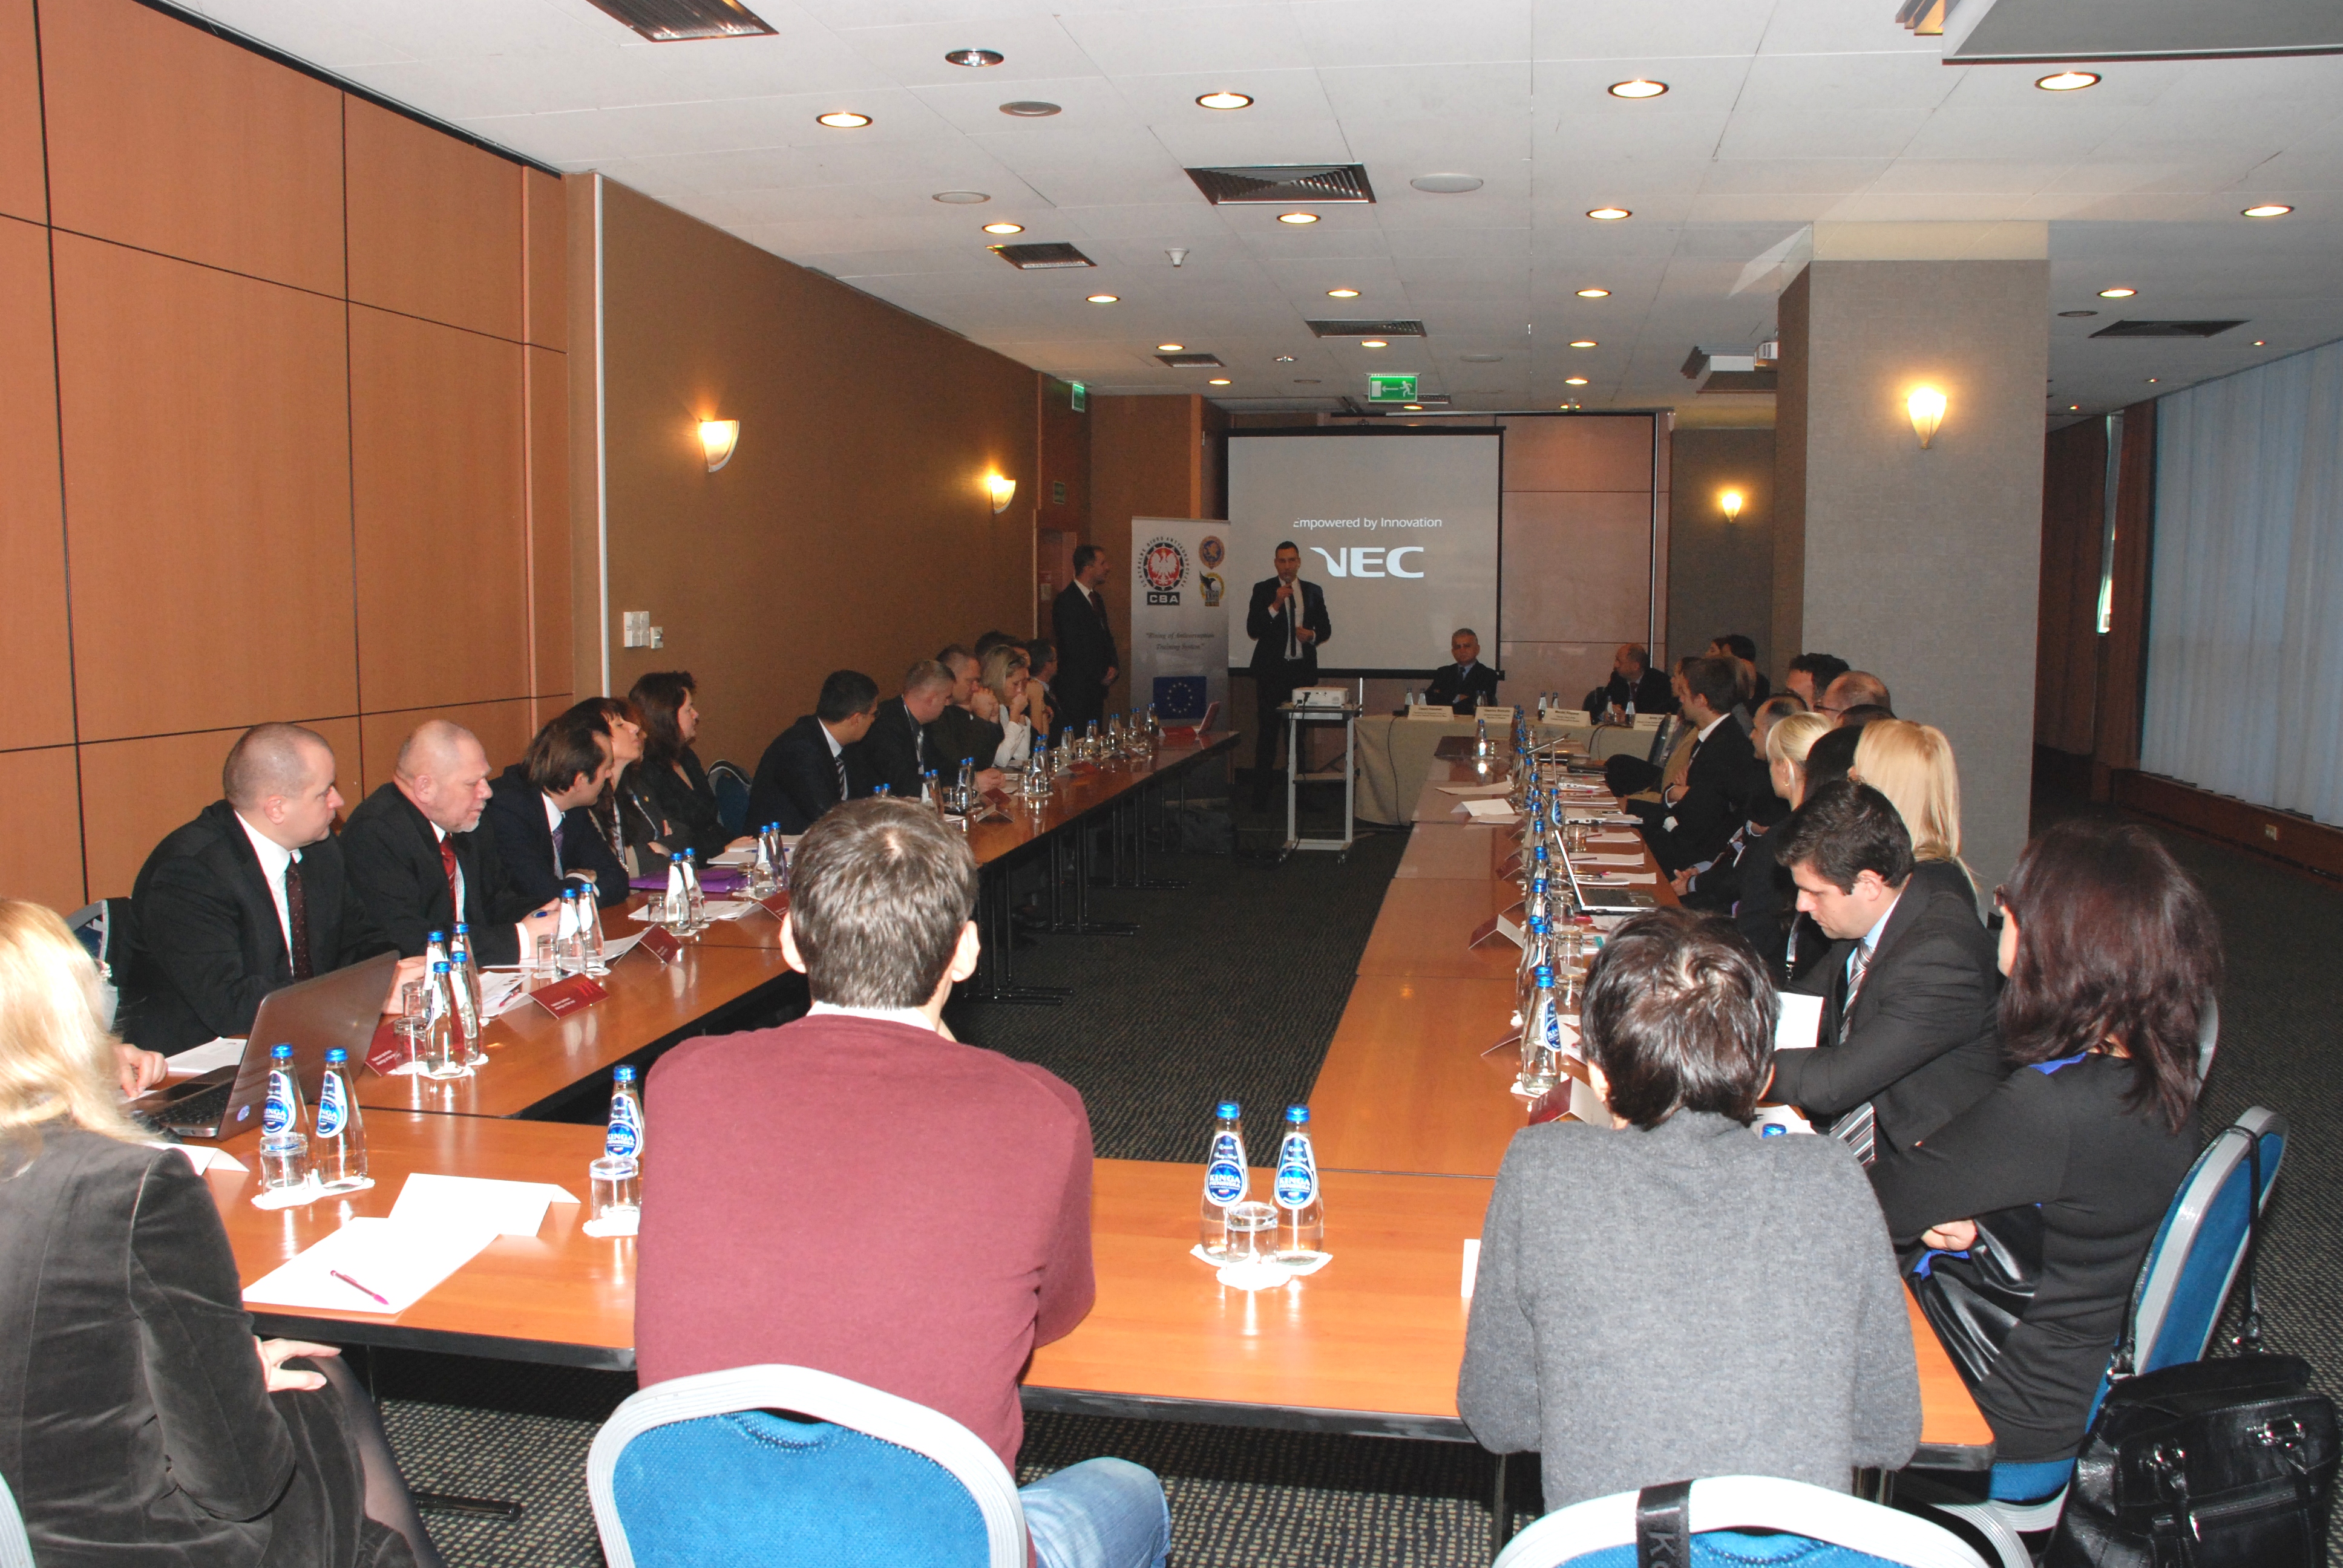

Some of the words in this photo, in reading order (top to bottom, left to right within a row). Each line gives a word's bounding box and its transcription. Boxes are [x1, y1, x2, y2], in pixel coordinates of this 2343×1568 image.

[1364, 518, 1377, 530] by
[1381, 517, 1442, 528] Innovation
[1309, 546, 1424, 578] NEC
[1150, 595, 1178, 603] CBA
[1210, 1174, 1241, 1184] KINGA
[1279, 1177, 1311, 1187] KINGA
